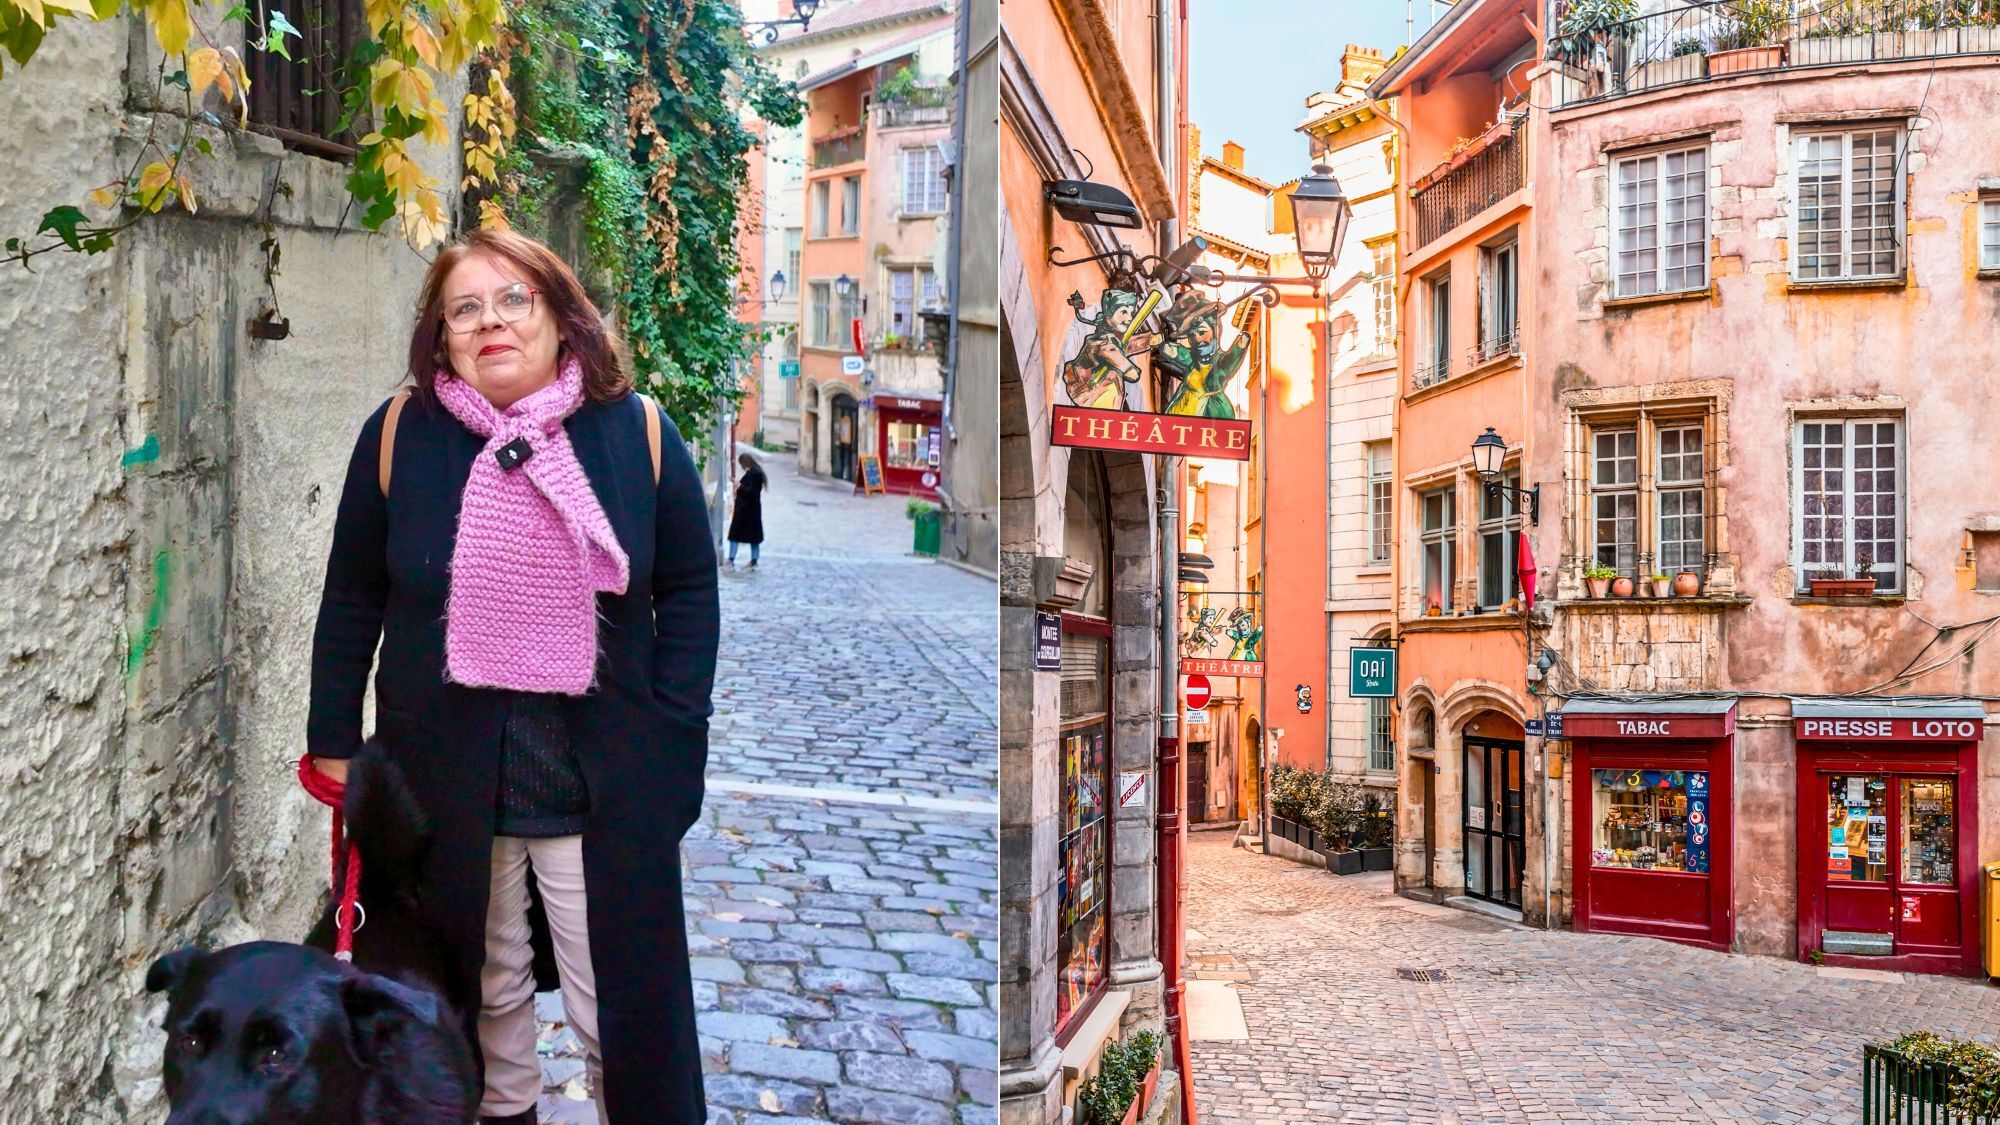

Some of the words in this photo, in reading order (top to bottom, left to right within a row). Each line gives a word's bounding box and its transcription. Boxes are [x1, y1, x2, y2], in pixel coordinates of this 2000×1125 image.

[897, 399, 921, 409] TABAC
[1060, 415, 1245, 450] THÉÂTRE
[1183, 661, 1262, 675] THÉÂTRE
[1616, 720, 1670, 735] TABAC
[1804, 721, 1893, 736] PRESSE
[1912, 721, 1975, 737] LOTO
[1122, 777, 1143, 803] LICENCE
